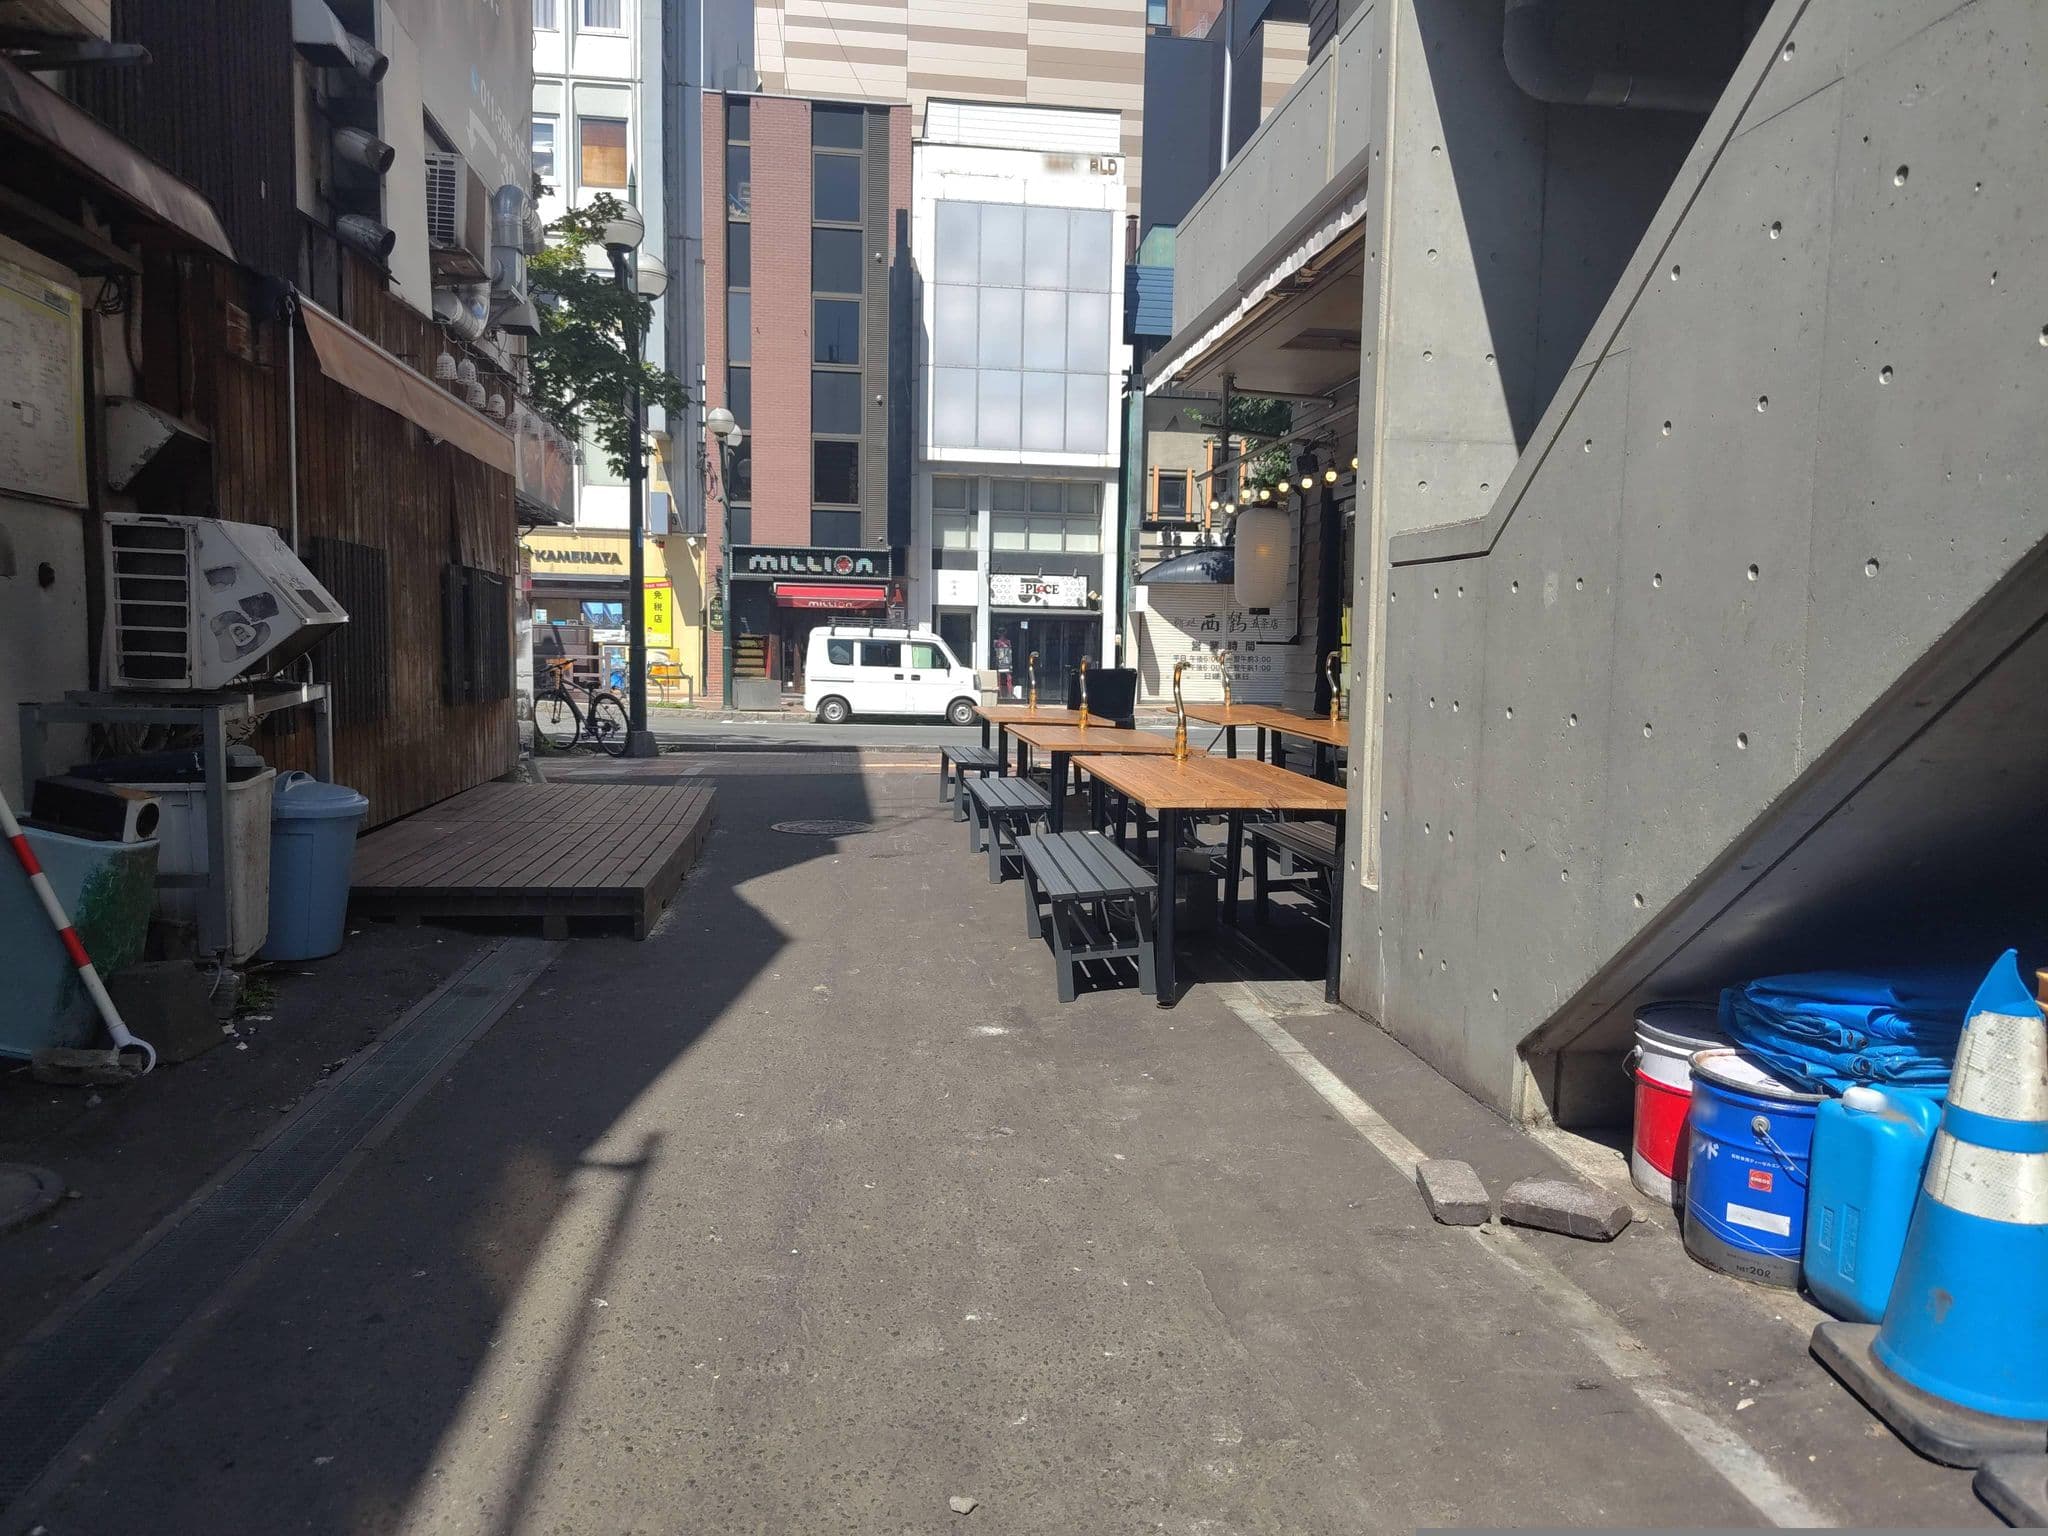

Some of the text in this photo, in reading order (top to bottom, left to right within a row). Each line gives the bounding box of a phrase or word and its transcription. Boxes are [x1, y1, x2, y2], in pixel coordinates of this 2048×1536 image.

[1089, 158, 1117, 176] BLD
[653, 590, 663, 624] 免税店
[1191, 640, 1256, 651] 営業時間
